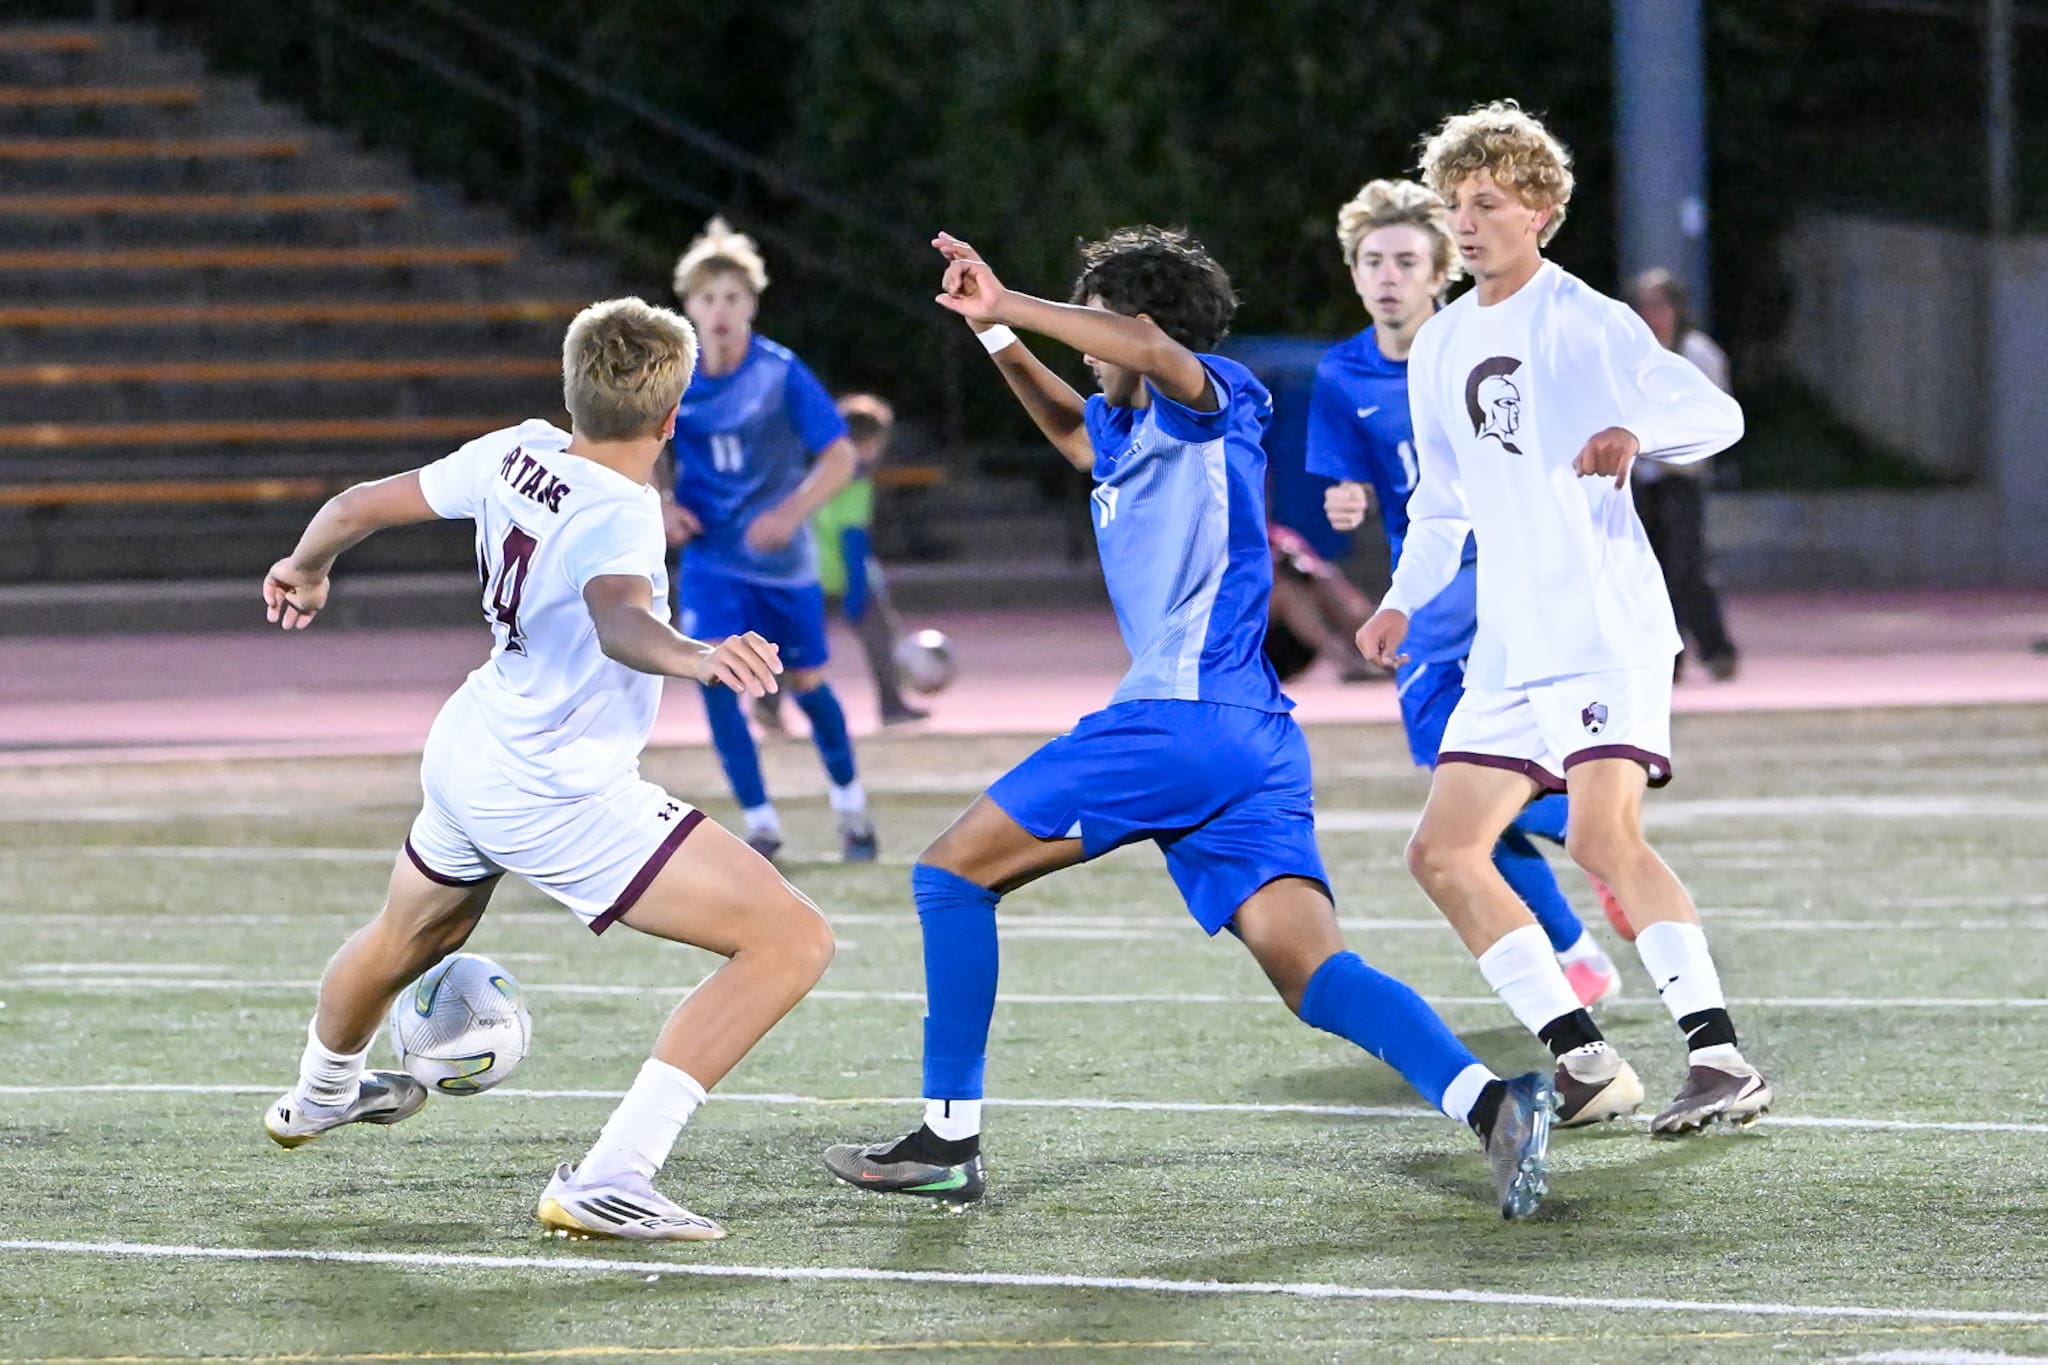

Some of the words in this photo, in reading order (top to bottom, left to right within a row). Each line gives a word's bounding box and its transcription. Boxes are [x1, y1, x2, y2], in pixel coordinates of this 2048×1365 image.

[502, 445, 571, 514] RTANS
[709, 434, 744, 473] 11
[481, 523, 540, 653] 4
